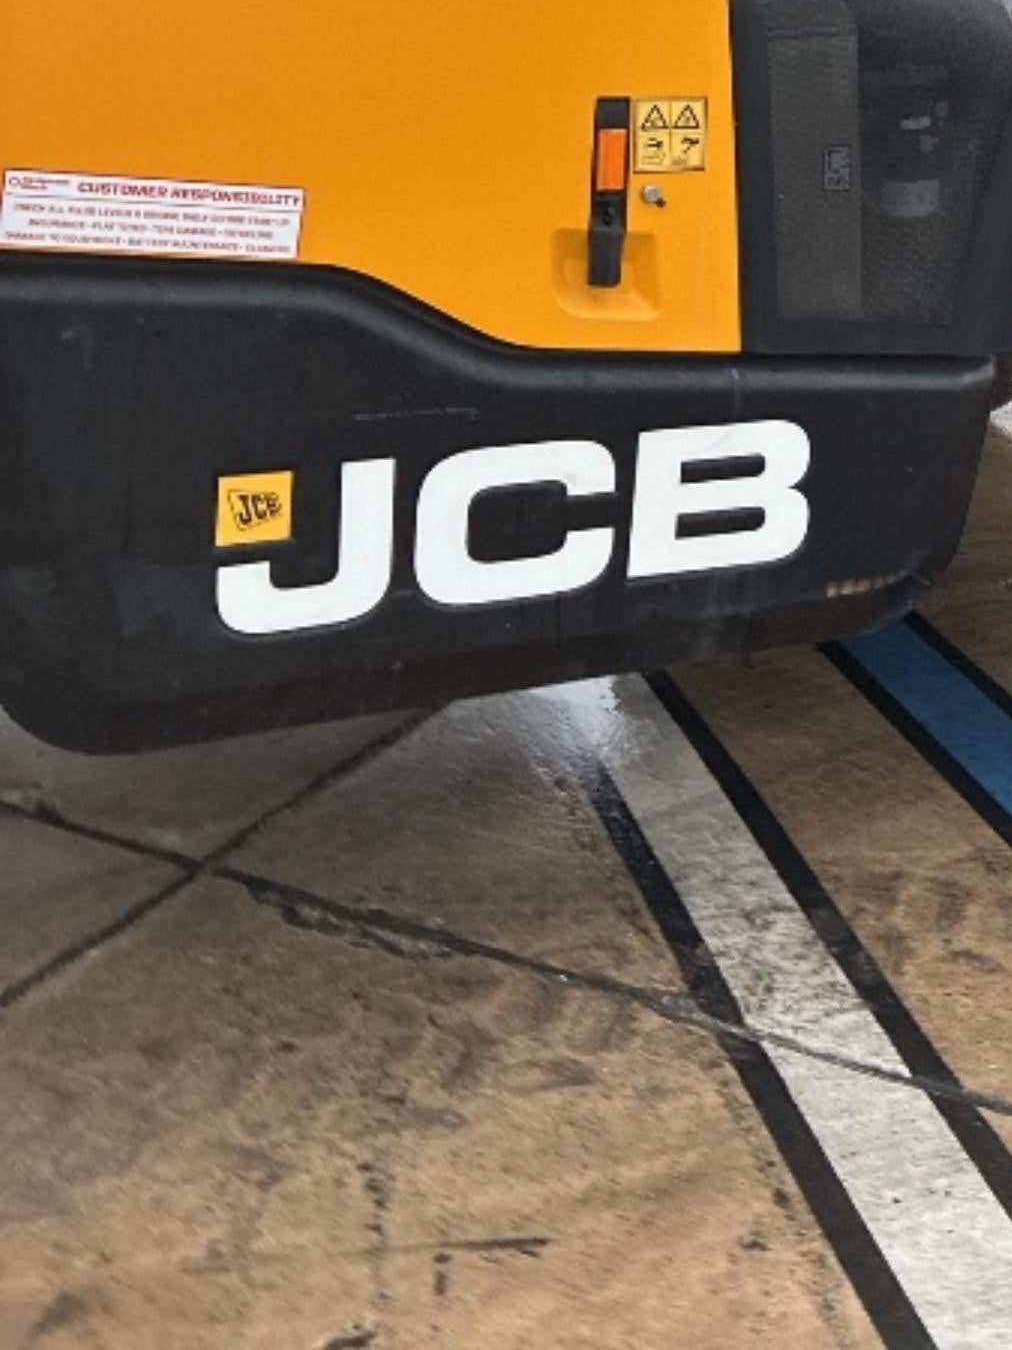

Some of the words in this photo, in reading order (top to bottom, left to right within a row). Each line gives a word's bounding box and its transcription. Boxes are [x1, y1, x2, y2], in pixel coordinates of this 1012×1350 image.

[77, 181, 168, 198] CUSTOMER
[237, 492, 281, 525] JCB
[214, 419, 812, 635] JCB
